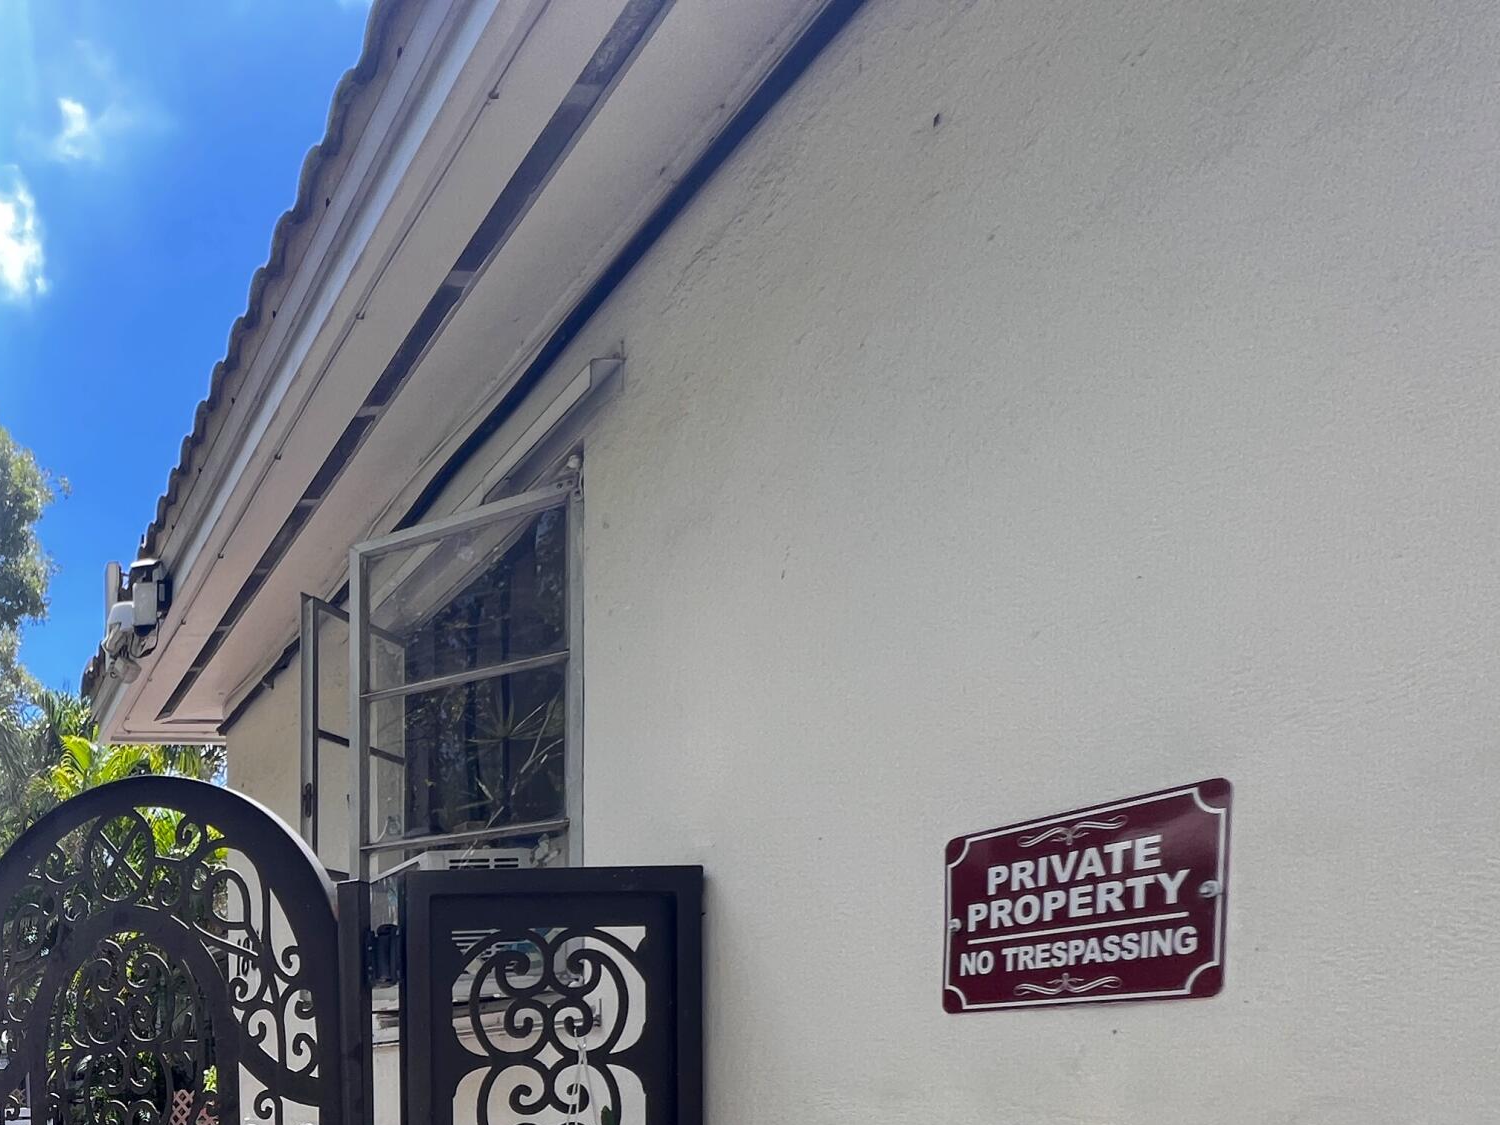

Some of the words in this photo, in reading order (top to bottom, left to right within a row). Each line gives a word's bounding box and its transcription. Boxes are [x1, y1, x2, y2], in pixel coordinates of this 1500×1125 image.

[987, 834, 1163, 896] PRIVATE
[967, 869, 1191, 932] PROPERTY
[959, 950, 995, 976] NO
[1001, 926, 1198, 972] TRESPASSING
